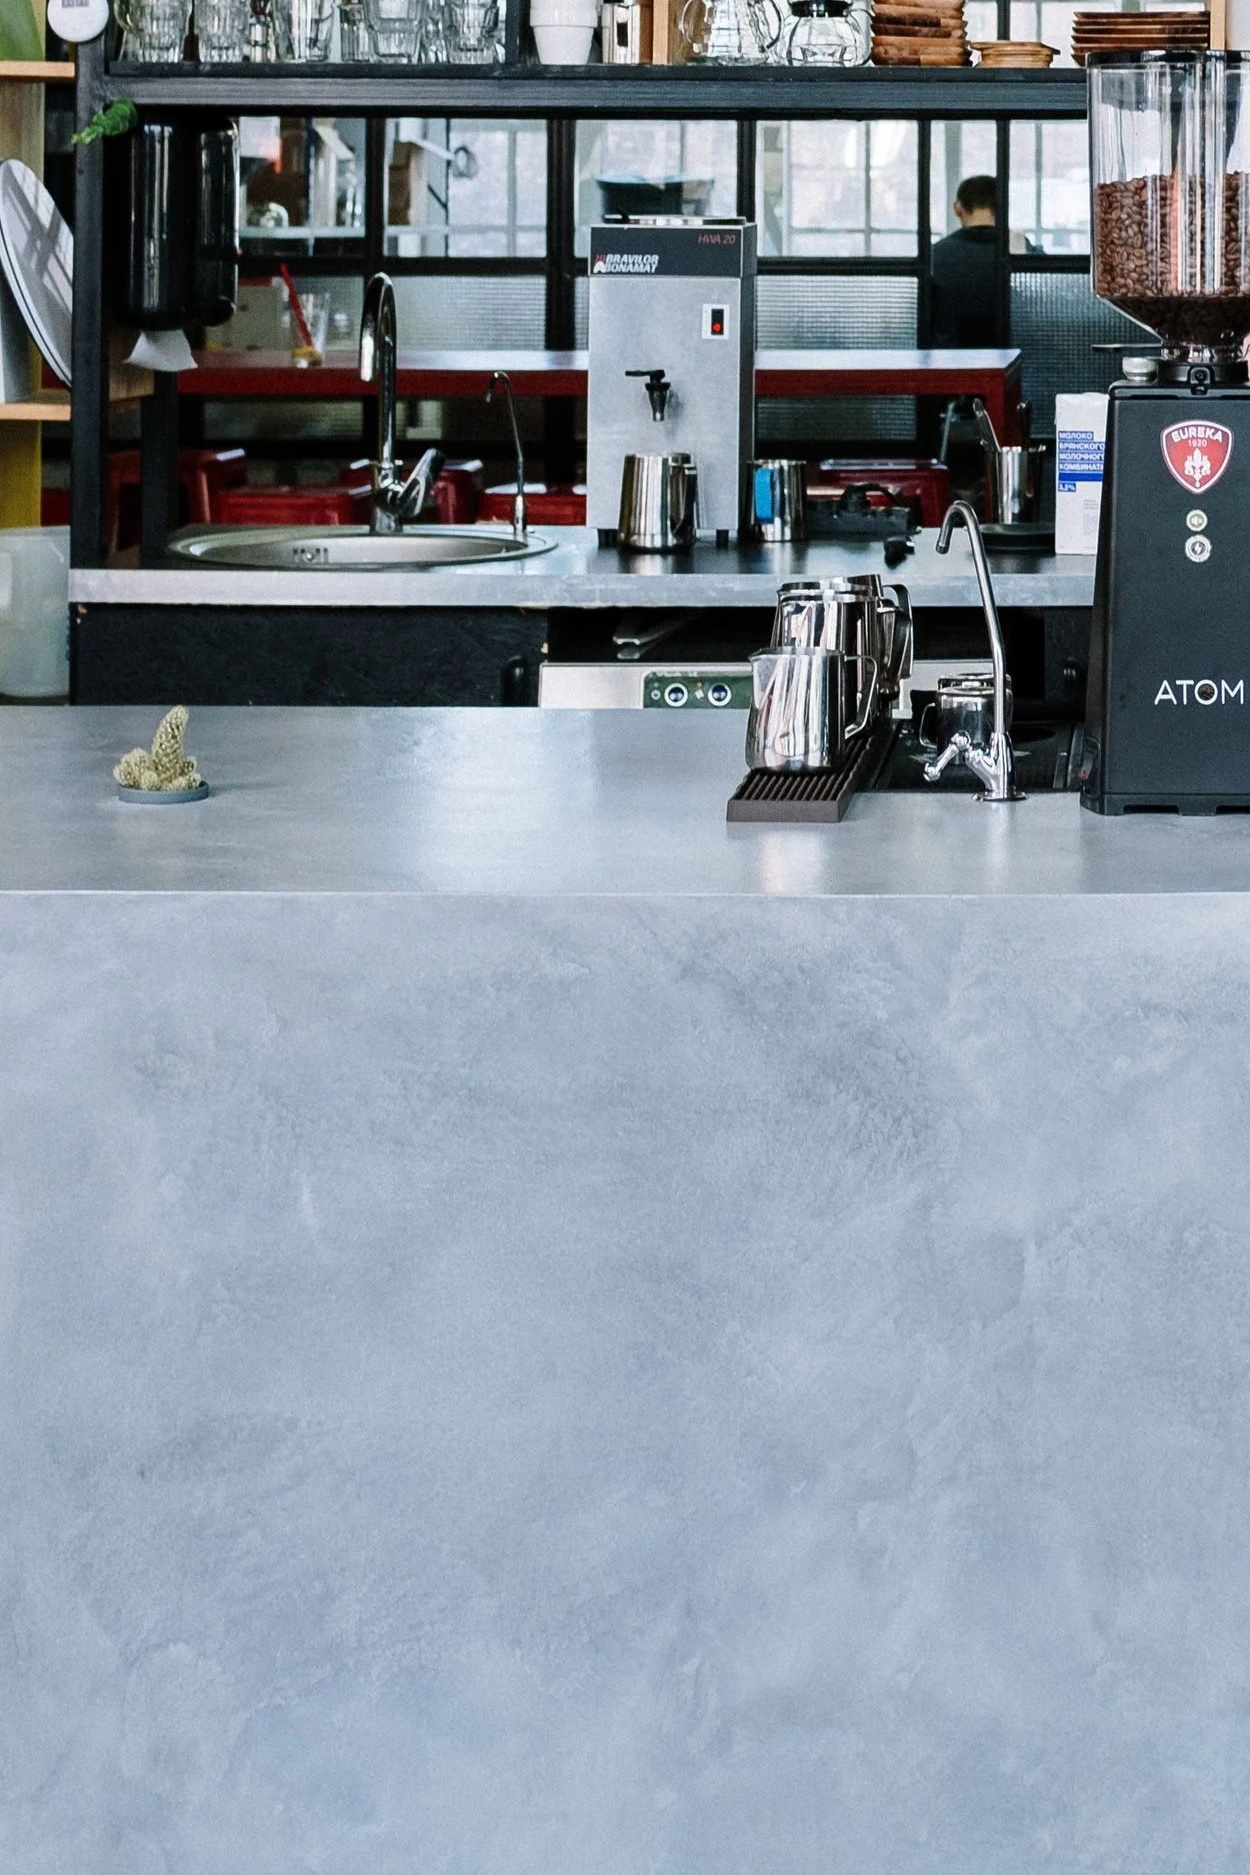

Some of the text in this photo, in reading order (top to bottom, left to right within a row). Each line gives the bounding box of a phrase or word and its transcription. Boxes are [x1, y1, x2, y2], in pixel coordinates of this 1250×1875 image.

[698, 234, 736, 244] HWA 20
[605, 253, 659, 265] BRAVILOR
[604, 262, 658, 273] BONAMAT
[1059, 432, 1093, 440] МОЛОКО
[1171, 426, 1223, 443] EUREKA
[1187, 438, 1208, 448] 1920
[1154, 679, 1244, 705] ATOM
